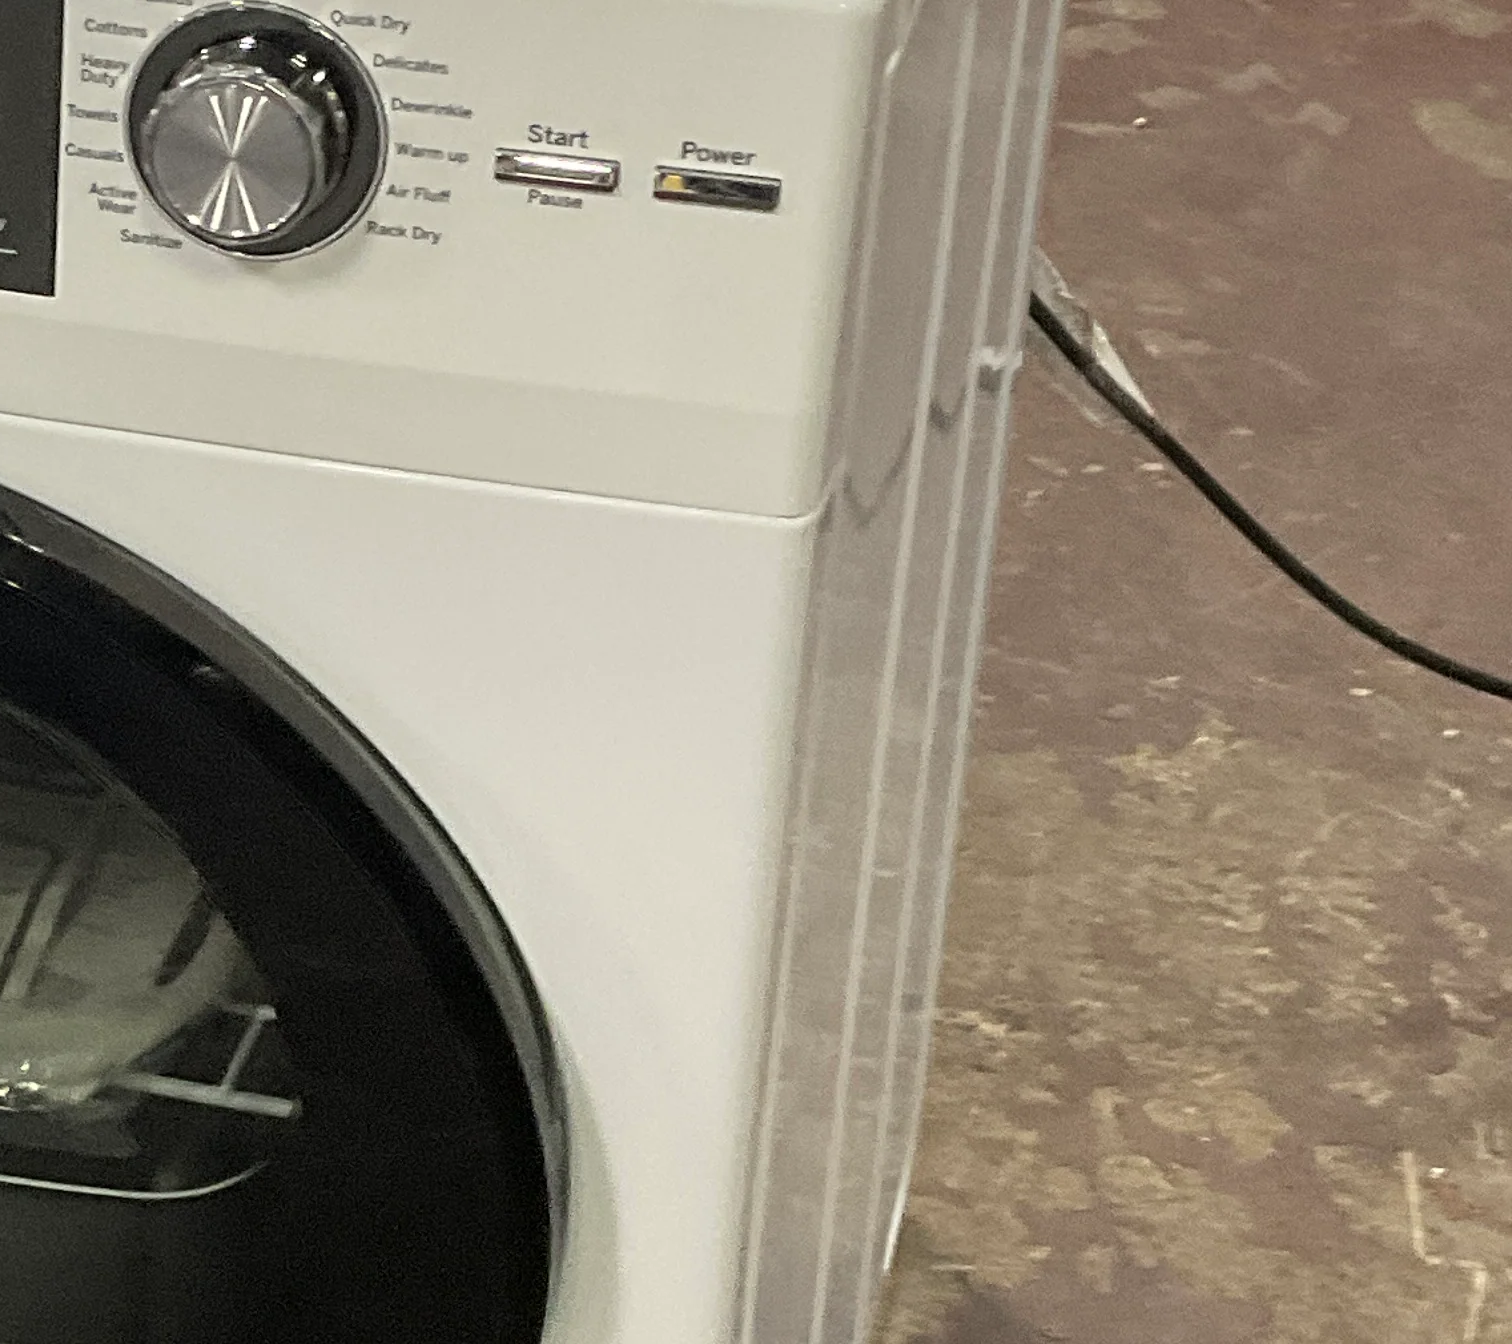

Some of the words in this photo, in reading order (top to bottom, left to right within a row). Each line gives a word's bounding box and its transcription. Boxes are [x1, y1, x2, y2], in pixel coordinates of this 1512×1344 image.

[84, 17, 148, 38] Cottons
[330, 9, 376, 27] Quick
[380, 15, 412, 35] Dry
[527, 123, 590, 149] Start
[681, 140, 757, 166] Power
[526, 189, 584, 210] Pause
[411, 226, 443, 246] Dry
